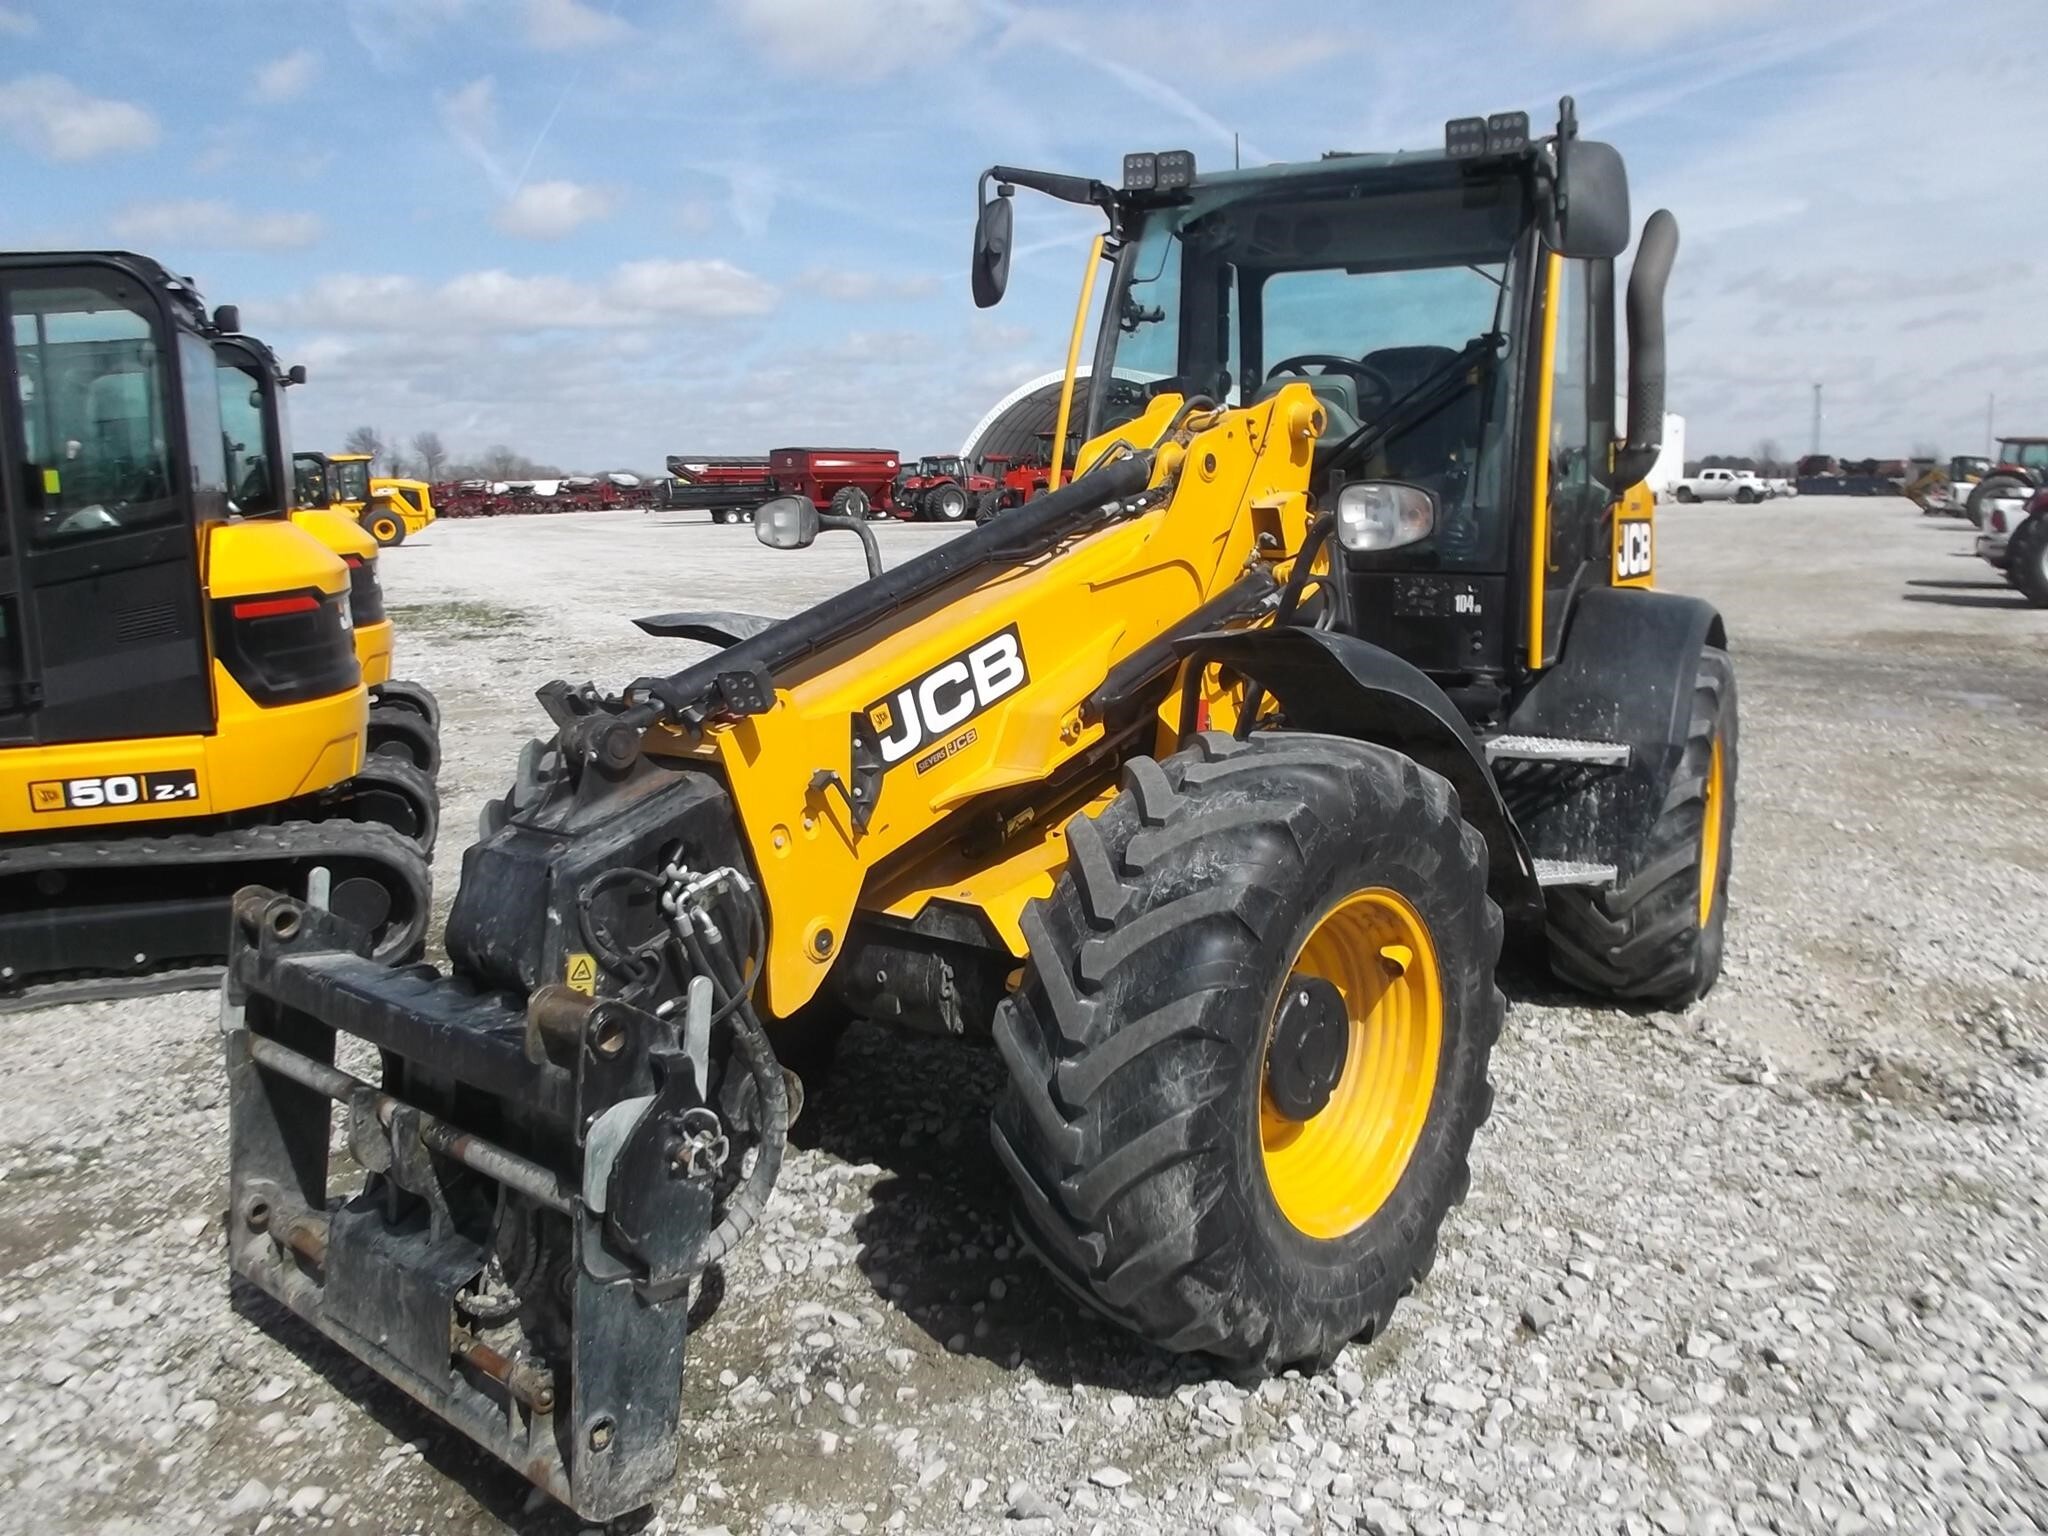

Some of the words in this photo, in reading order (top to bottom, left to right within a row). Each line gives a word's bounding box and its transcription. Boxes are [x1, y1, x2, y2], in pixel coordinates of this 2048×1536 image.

[1617, 522, 1652, 577] JCB
[1454, 594, 1475, 613] 104
[879, 633, 1025, 763] JCB
[917, 748, 946, 773] SIEVERS
[948, 729, 978, 755] JCB
[69, 776, 139, 807] 50
[154, 782, 198, 800] Z-1
